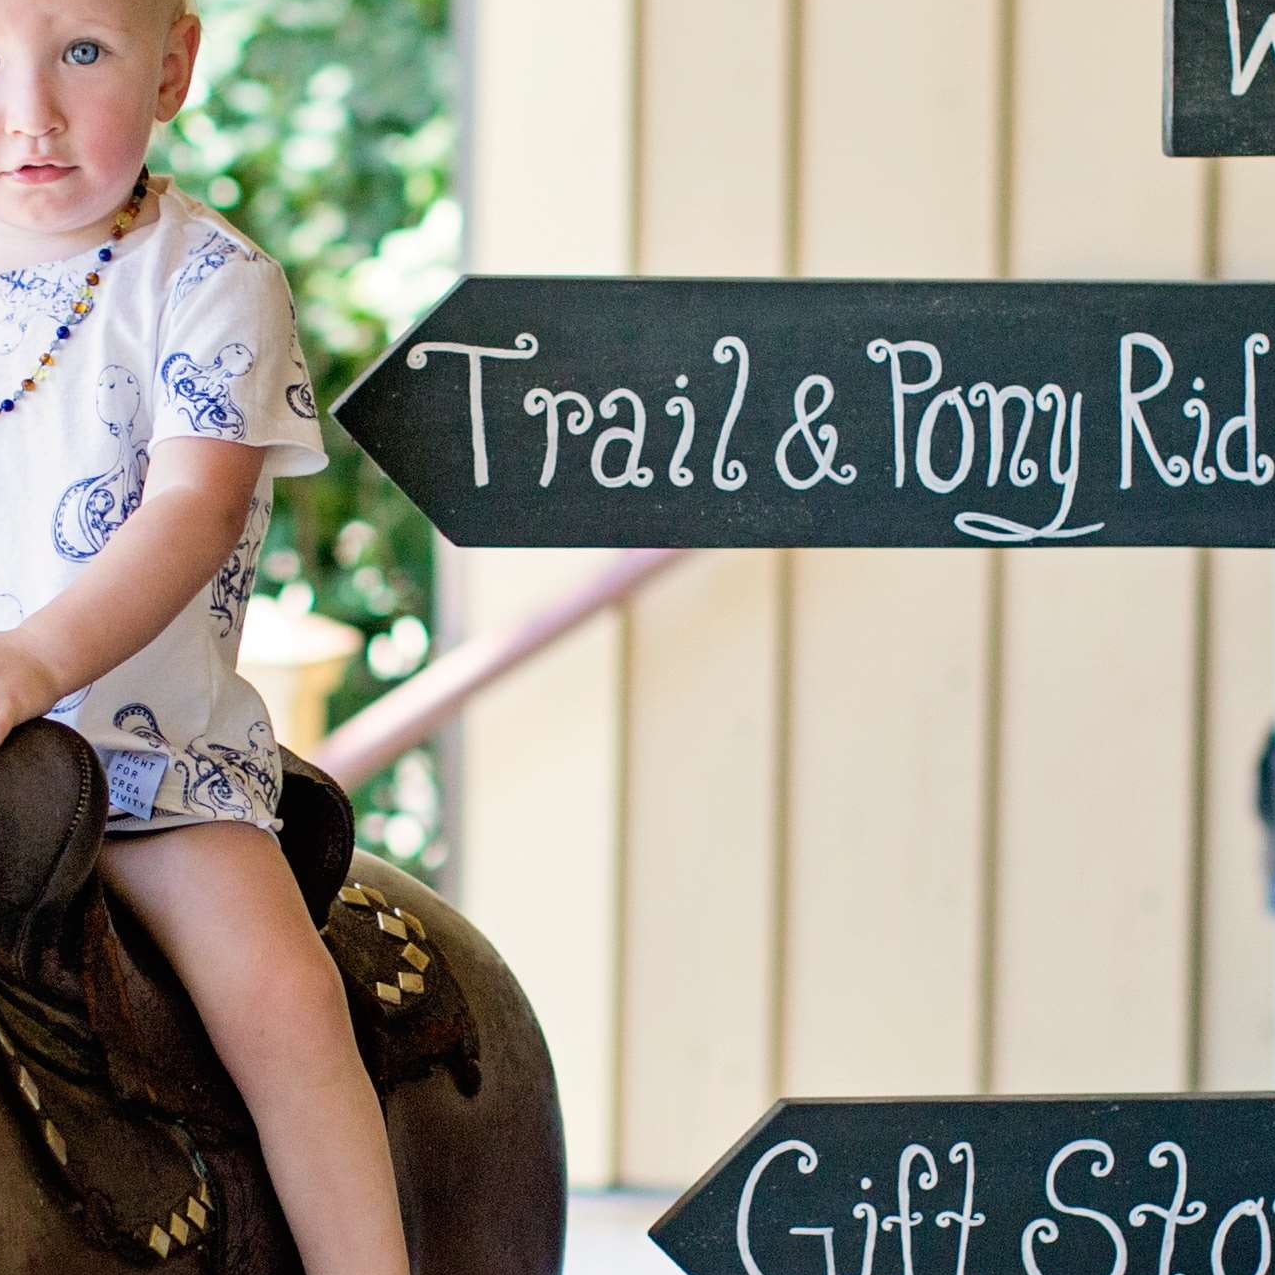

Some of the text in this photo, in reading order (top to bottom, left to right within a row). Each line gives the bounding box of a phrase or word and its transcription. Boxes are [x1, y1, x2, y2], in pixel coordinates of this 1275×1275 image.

[406, 331, 750, 493] Trail
[773, 373, 858, 491] &
[865, 337, 1106, 543] Pony
[121, 750, 156, 771] FIGHT
[116, 763, 139, 780] FOR
[111, 776, 140, 795] CREA
[109, 788, 146, 809] TIVITY
